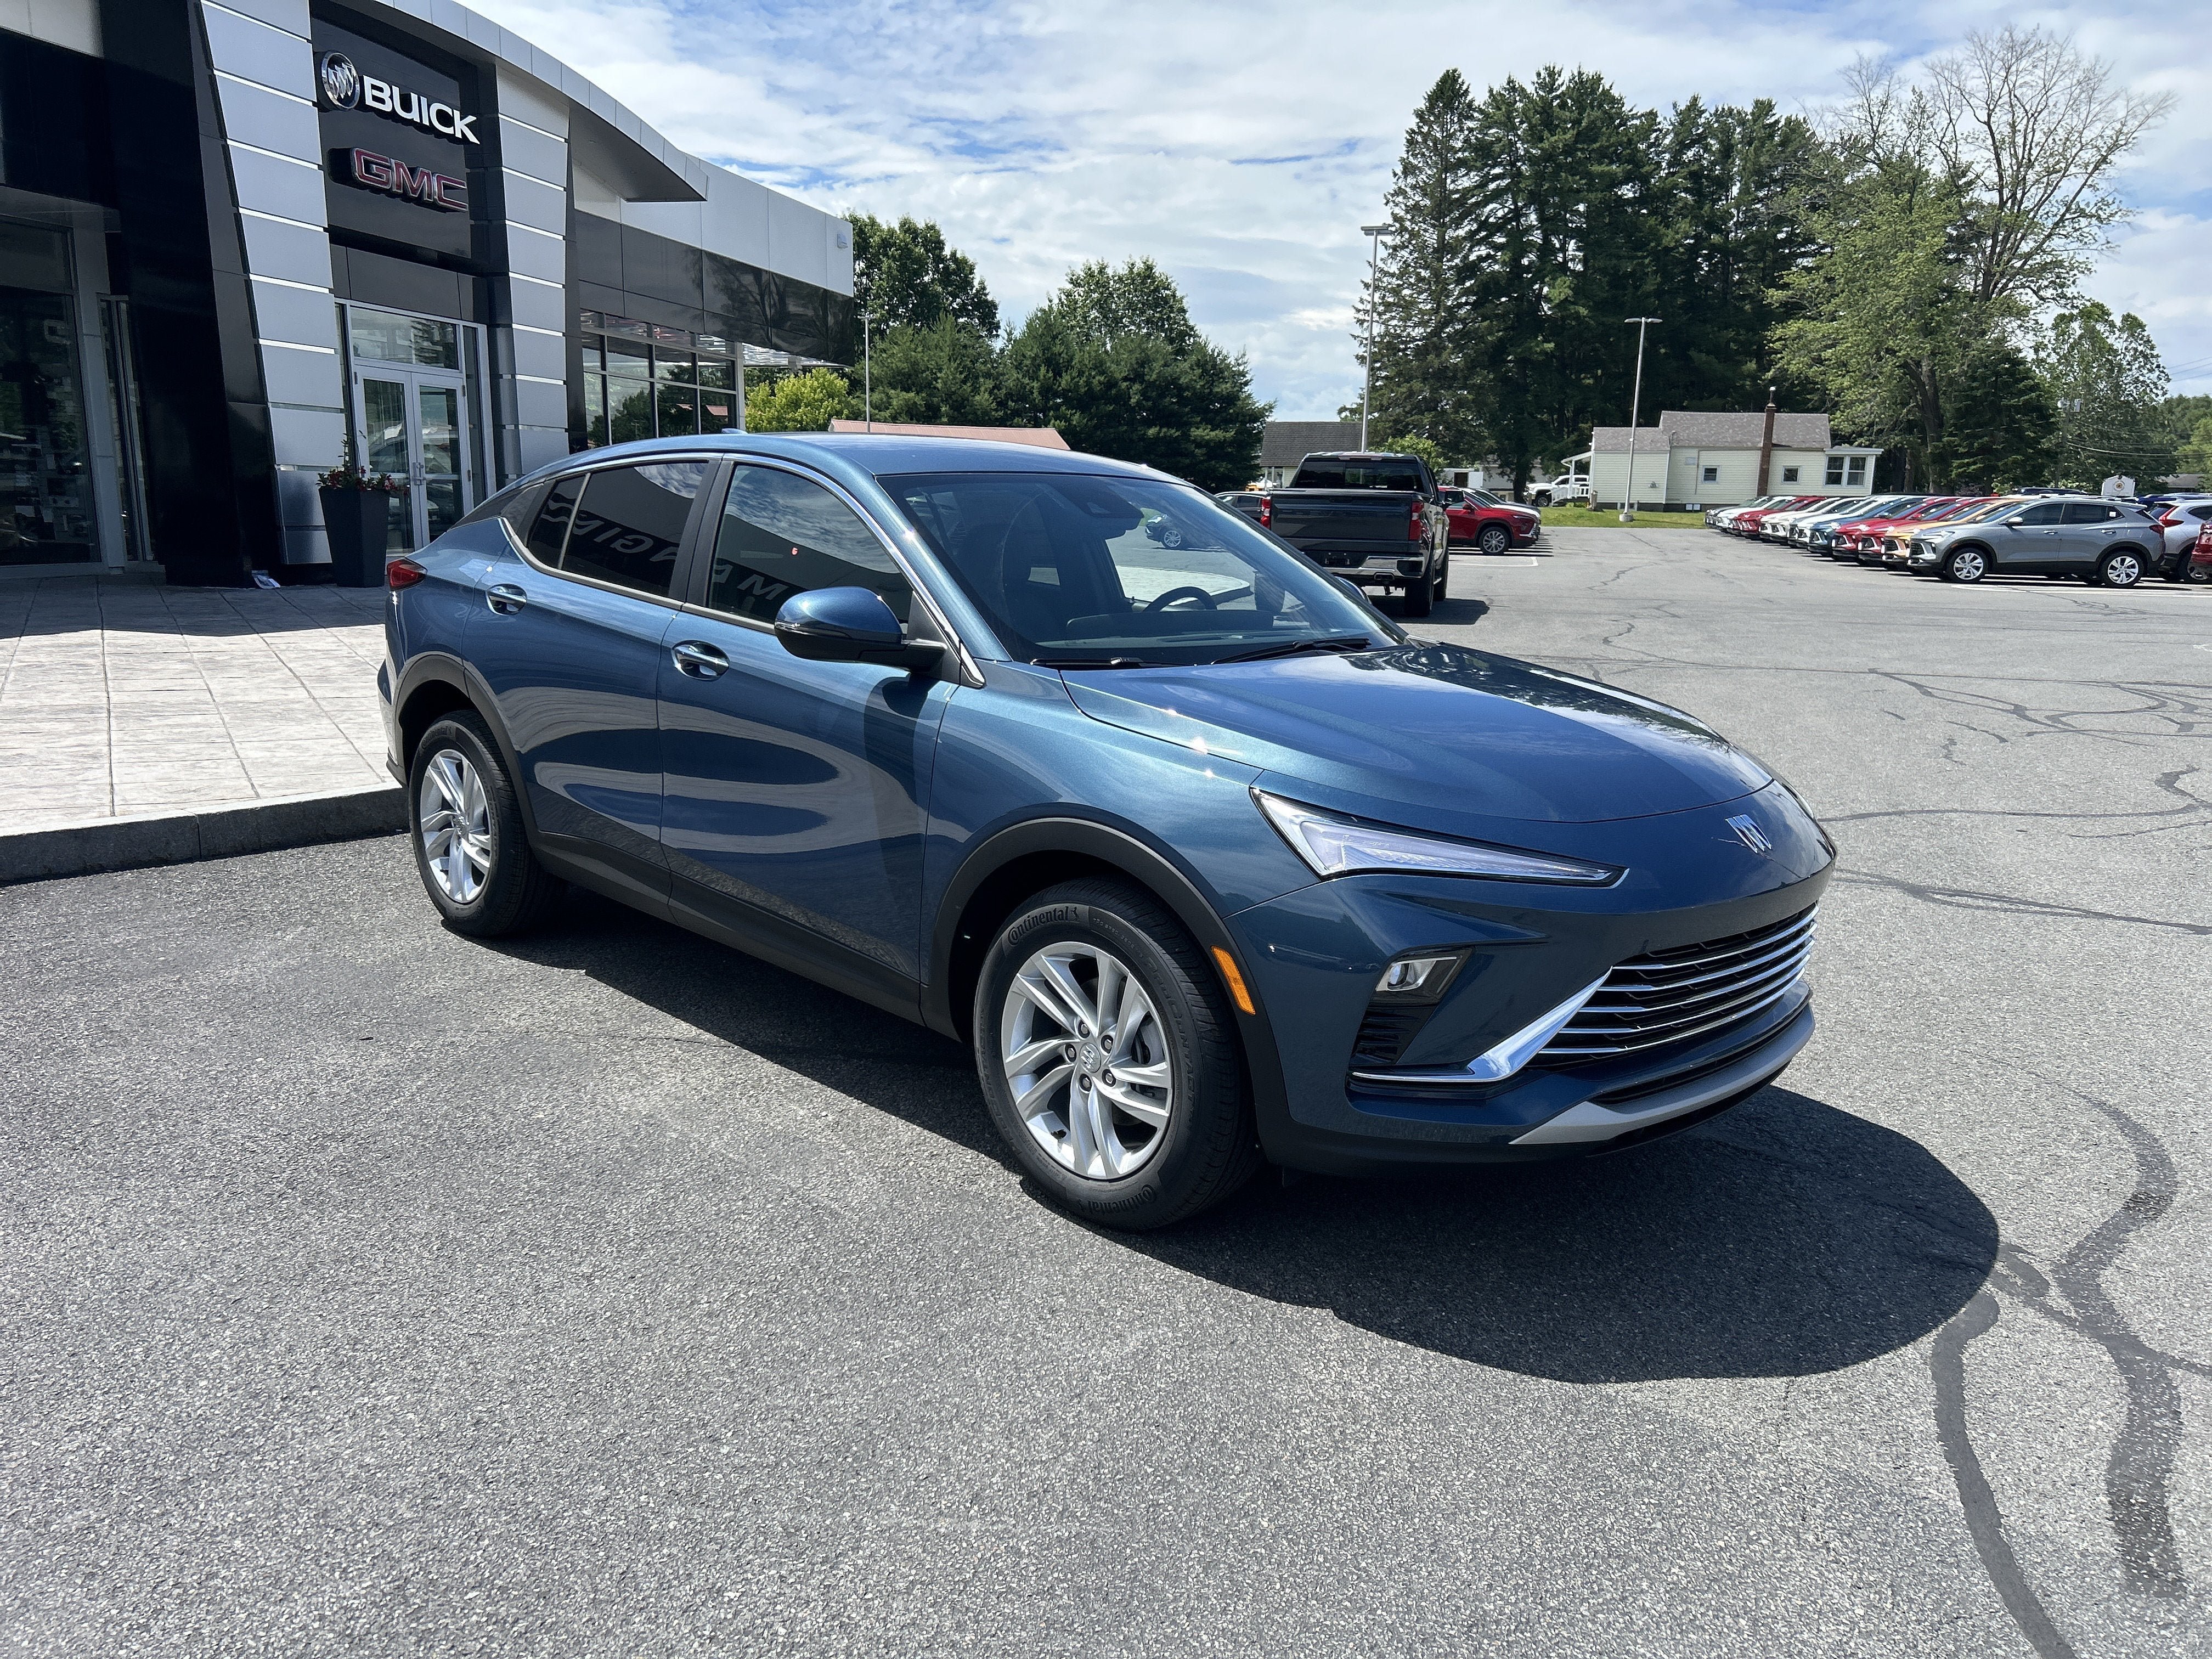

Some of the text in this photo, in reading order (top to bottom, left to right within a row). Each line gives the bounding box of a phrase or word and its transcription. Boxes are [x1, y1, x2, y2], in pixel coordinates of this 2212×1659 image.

[363, 75, 480, 144] BUICK
[351, 147, 469, 212] GMC
[1008, 906, 1069, 946] Continental
[1088, 1184, 1157, 1216] Continental
